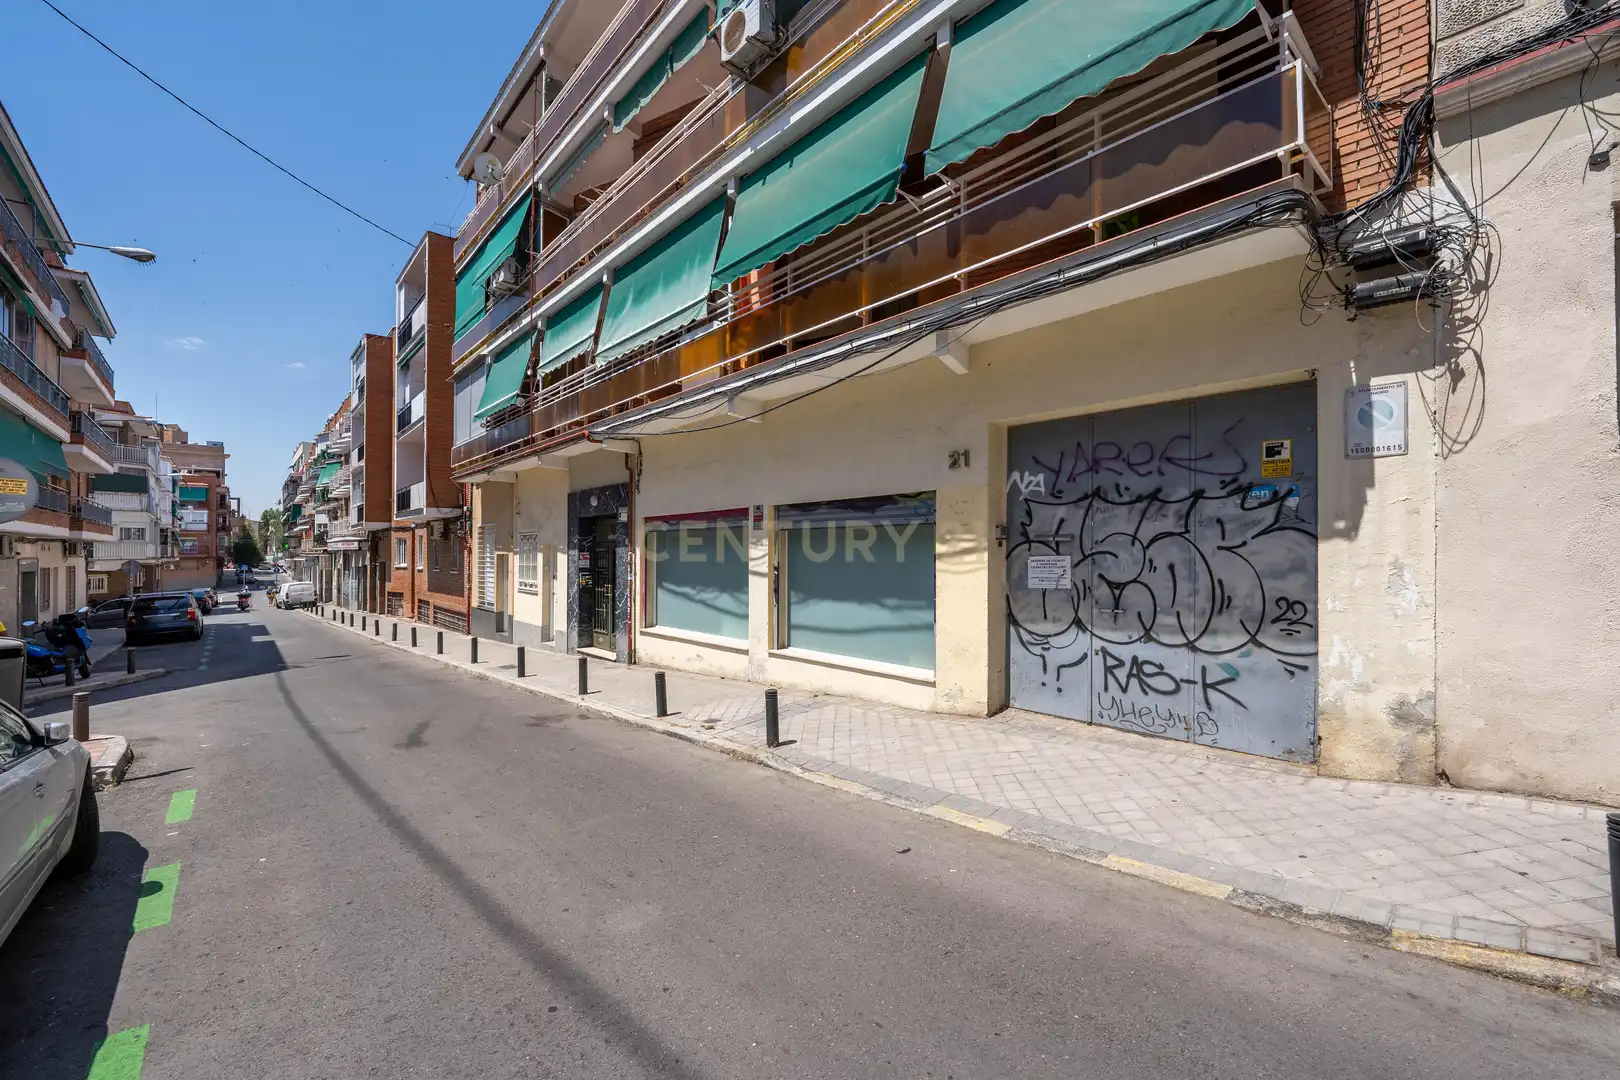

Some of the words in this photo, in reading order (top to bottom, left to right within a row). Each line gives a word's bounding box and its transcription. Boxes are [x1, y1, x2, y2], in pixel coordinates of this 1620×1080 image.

[1358, 384, 1396, 393] AYUNTAMIENTO
[1351, 444, 1403, 454] 1500001615
[949, 449, 970, 469] 21
[1271, 596, 1313, 628] 22
